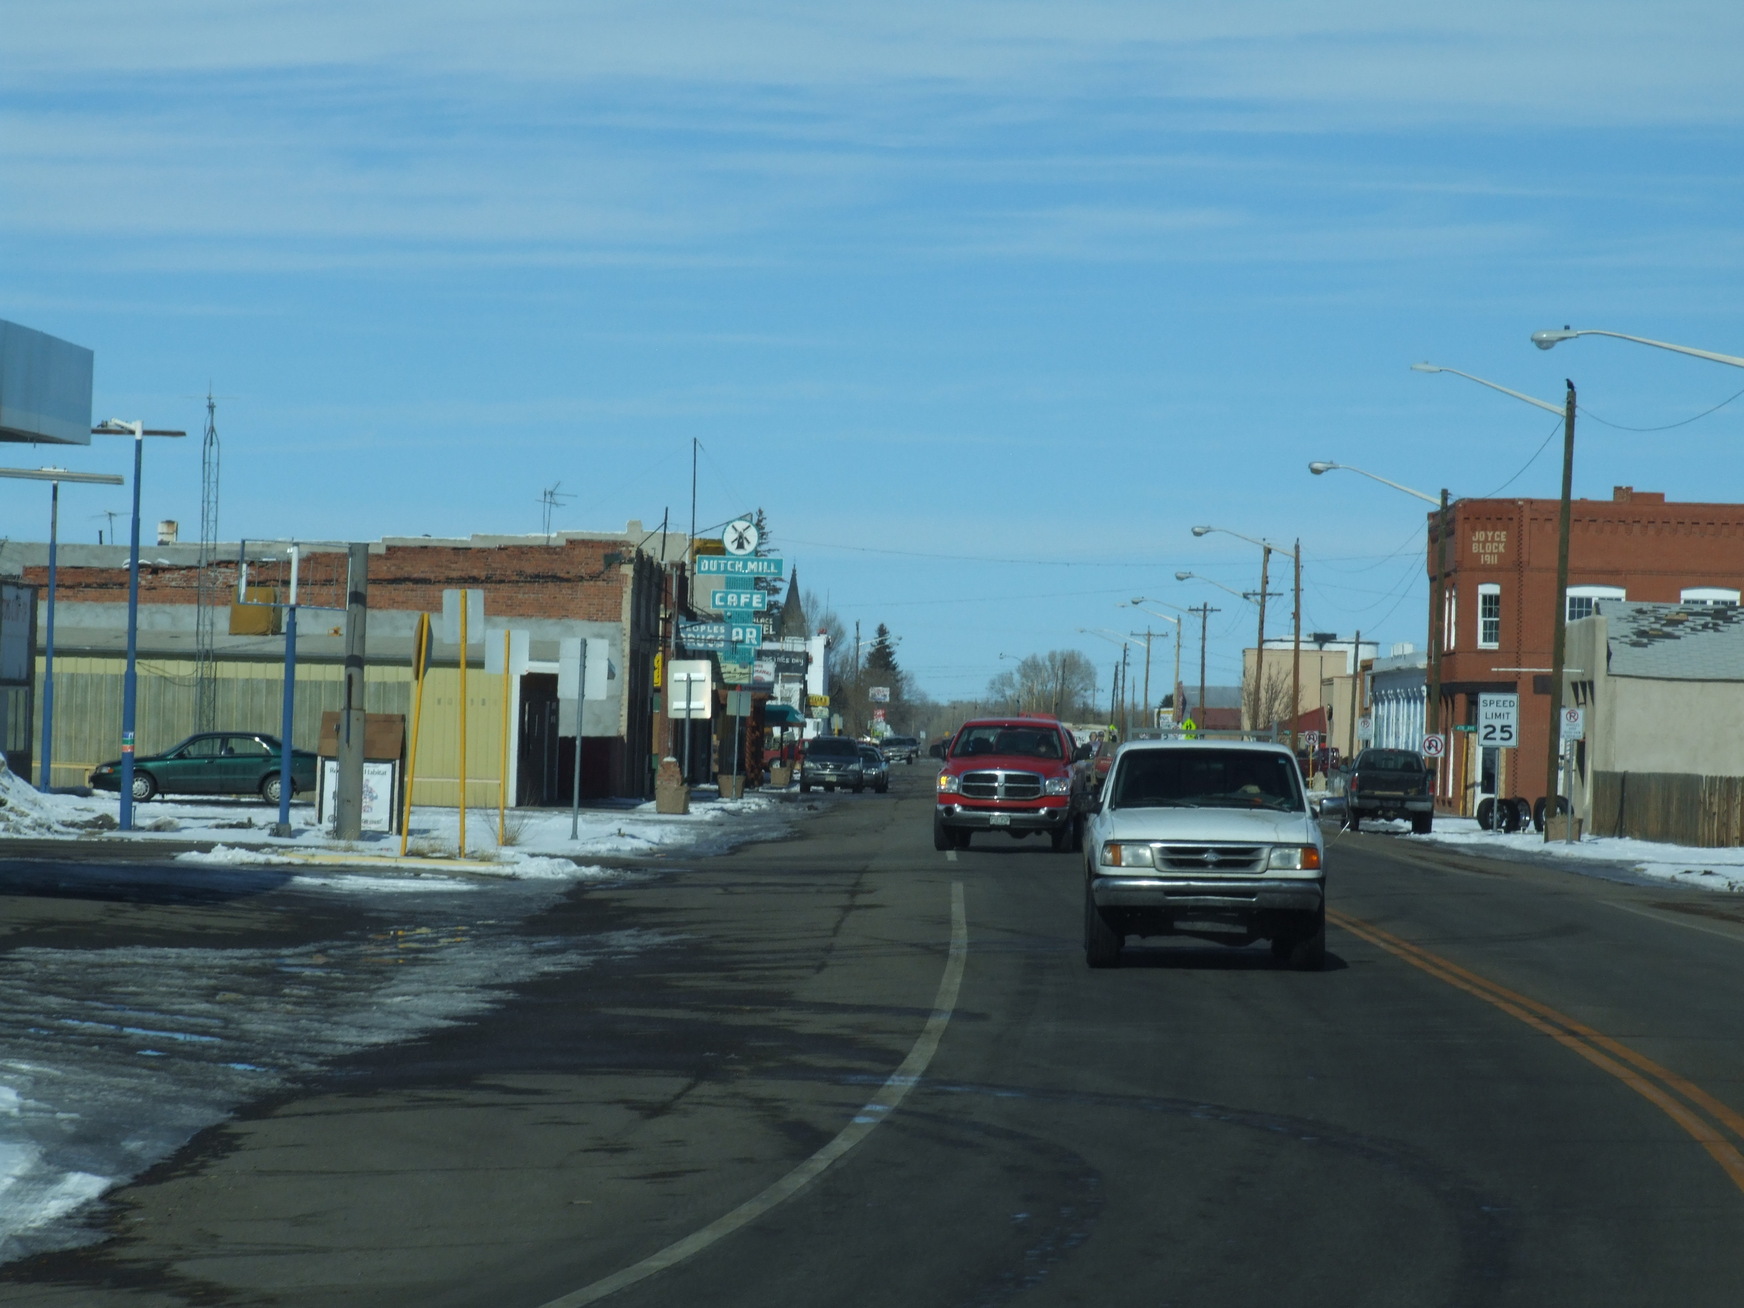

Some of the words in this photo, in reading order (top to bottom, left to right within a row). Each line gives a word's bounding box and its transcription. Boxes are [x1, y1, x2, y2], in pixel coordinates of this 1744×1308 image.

[1472, 531, 1507, 542] JOYCE
[1472, 542, 1505, 553] BLOCK
[1480, 554, 1498, 565] 1911
[701, 559, 743, 573] DUTCH
[747, 561, 778, 574] MILL
[715, 592, 763, 607] CAFE
[679, 624, 725, 633] PEOPLES
[731, 627, 758, 645] AR
[1482, 699, 1515, 708] SPEED
[1485, 711, 1510, 720] LIMIT
[1483, 724, 1513, 741] 25
